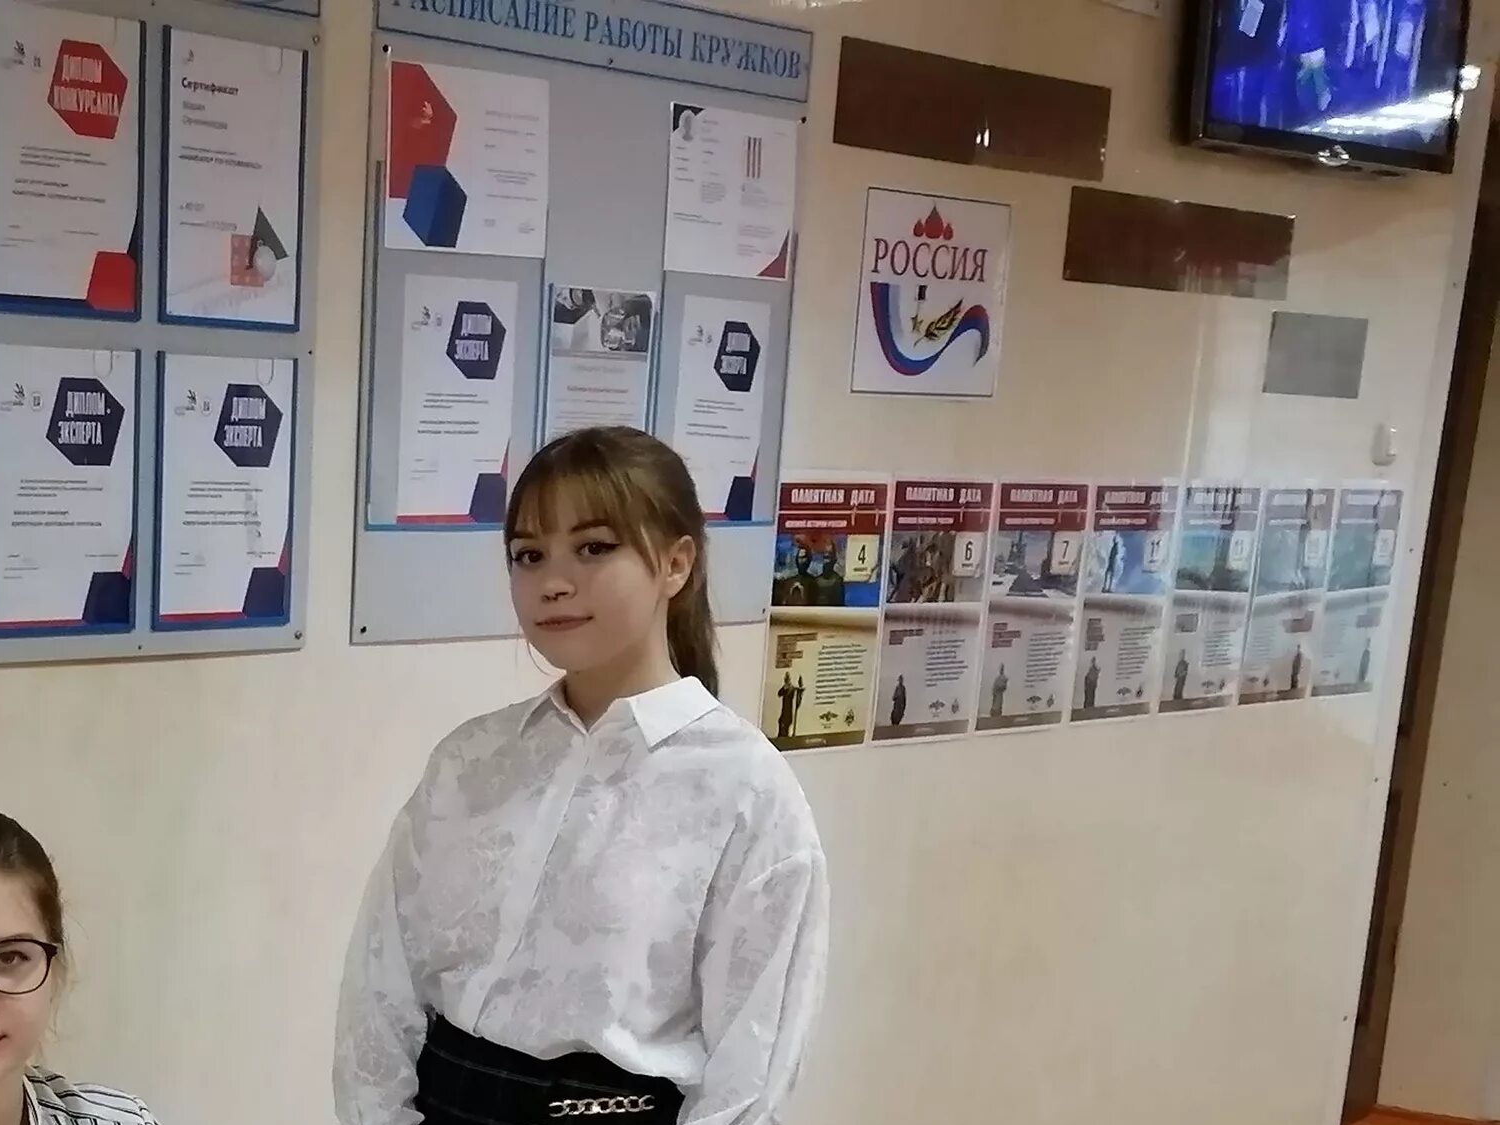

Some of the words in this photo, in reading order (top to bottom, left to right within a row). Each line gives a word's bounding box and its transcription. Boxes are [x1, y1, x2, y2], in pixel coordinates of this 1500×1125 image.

[392, 0, 577, 39] СПИСАНИЕ
[584, 10, 683, 59] РАБОТЫ
[690, 31, 801, 79] КРУЖКОВ
[182, 77, 239, 96] Сертификат
[871, 238, 988, 282] РОССИЯ
[65, 391, 106, 418] ДИПЛОМ
[58, 421, 103, 445] ЭКСПЕРТА
[791, 488, 845, 504] ПАМЯТНАЯ
[850, 489, 876, 507] ДАТА
[857, 544, 867, 566] 4
[965, 540, 975, 561] 6
[1062, 540, 1070, 560] 7
